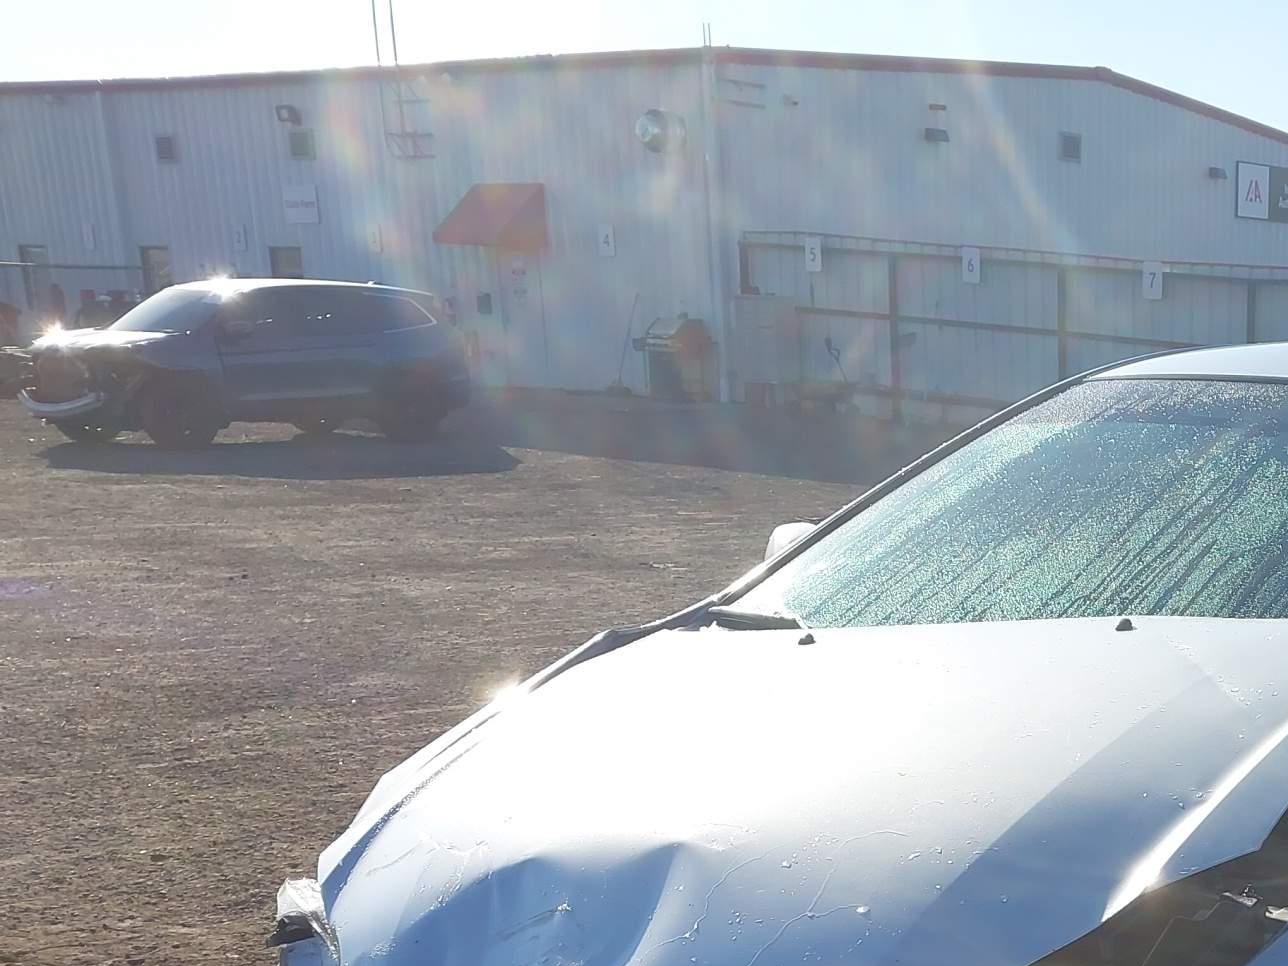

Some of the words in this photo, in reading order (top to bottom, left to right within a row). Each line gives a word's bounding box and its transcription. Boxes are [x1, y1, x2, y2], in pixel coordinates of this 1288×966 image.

[809, 247, 816, 262] 5
[967, 258, 975, 273] 6
[1149, 272, 1157, 288] 7
